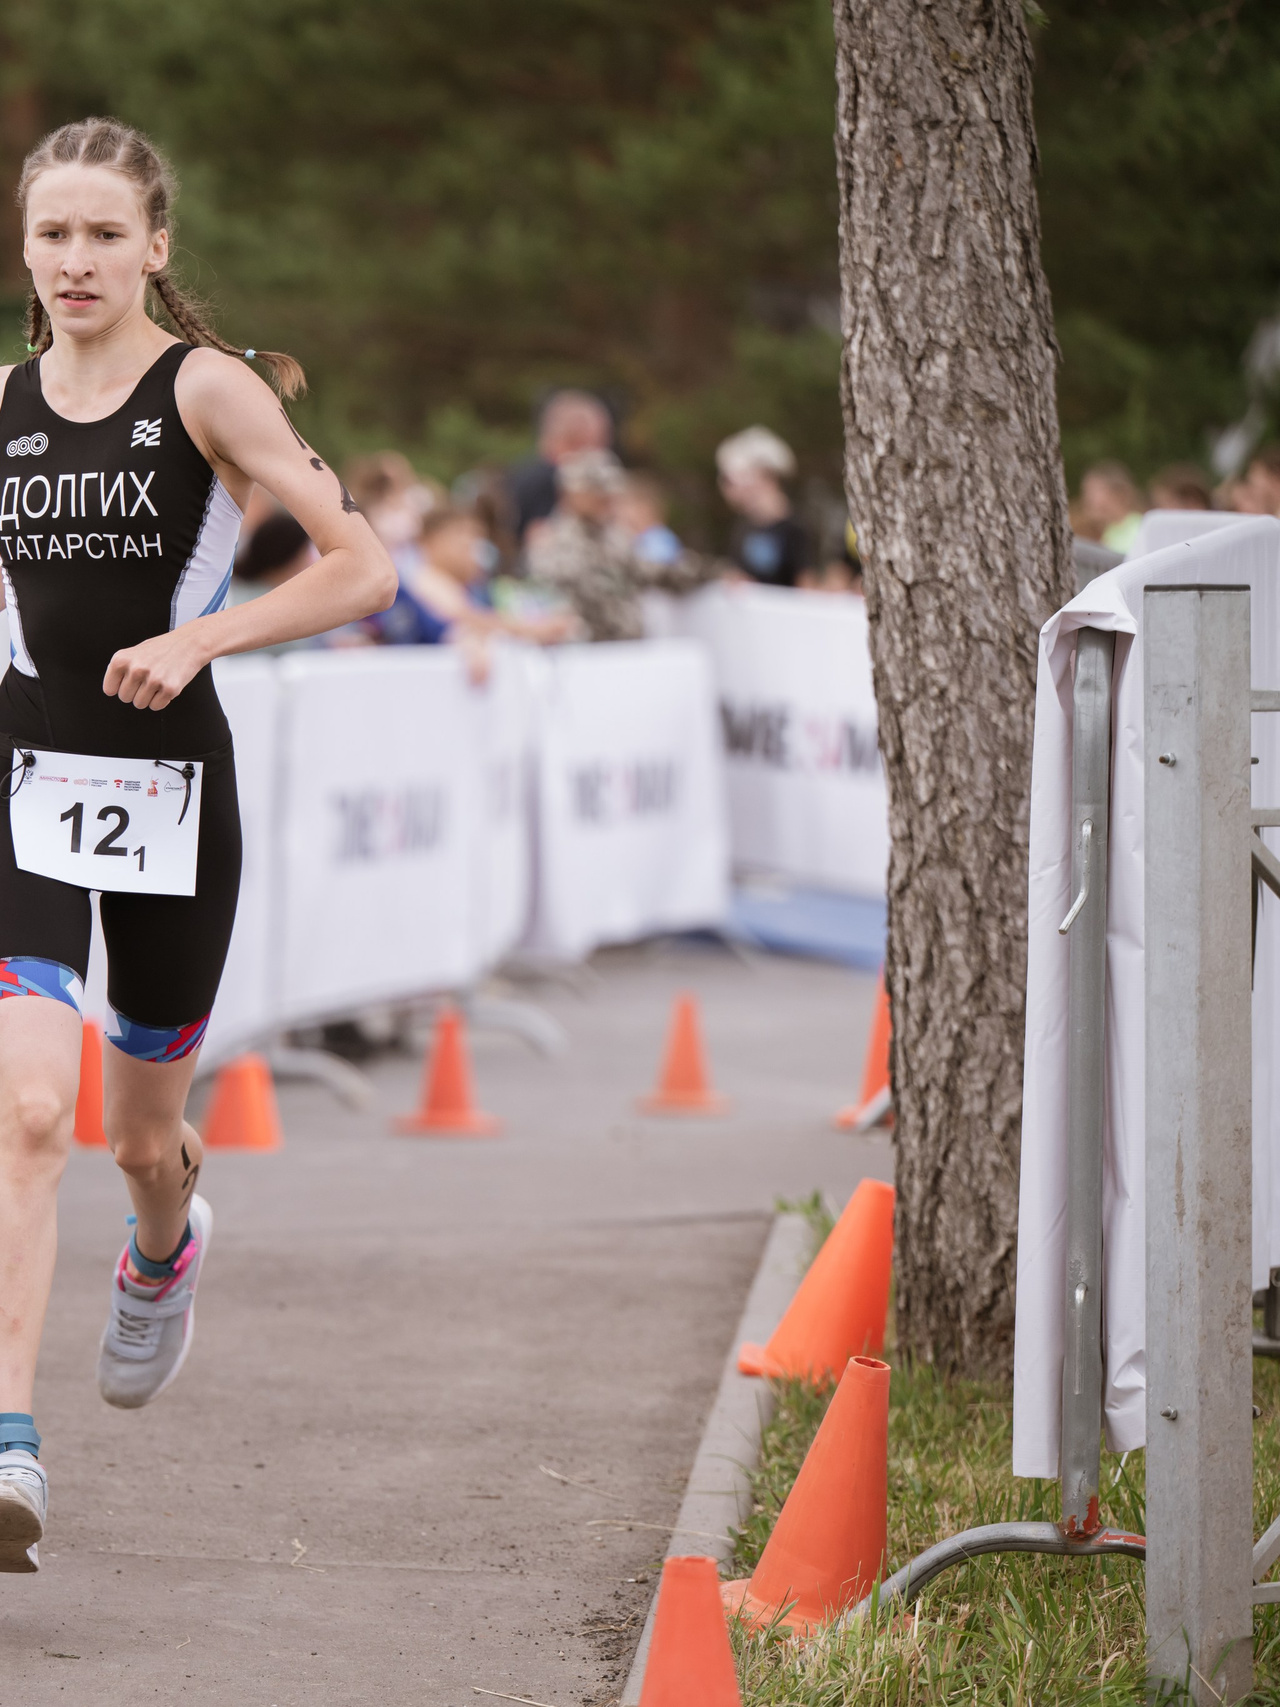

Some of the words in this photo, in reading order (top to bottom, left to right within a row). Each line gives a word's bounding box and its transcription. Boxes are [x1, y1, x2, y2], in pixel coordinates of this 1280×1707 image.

[0, 470, 159, 531] ДОЛГИХ
[0, 532, 163, 561] ТАТАРСТАН
[60, 801, 130, 857] 12
